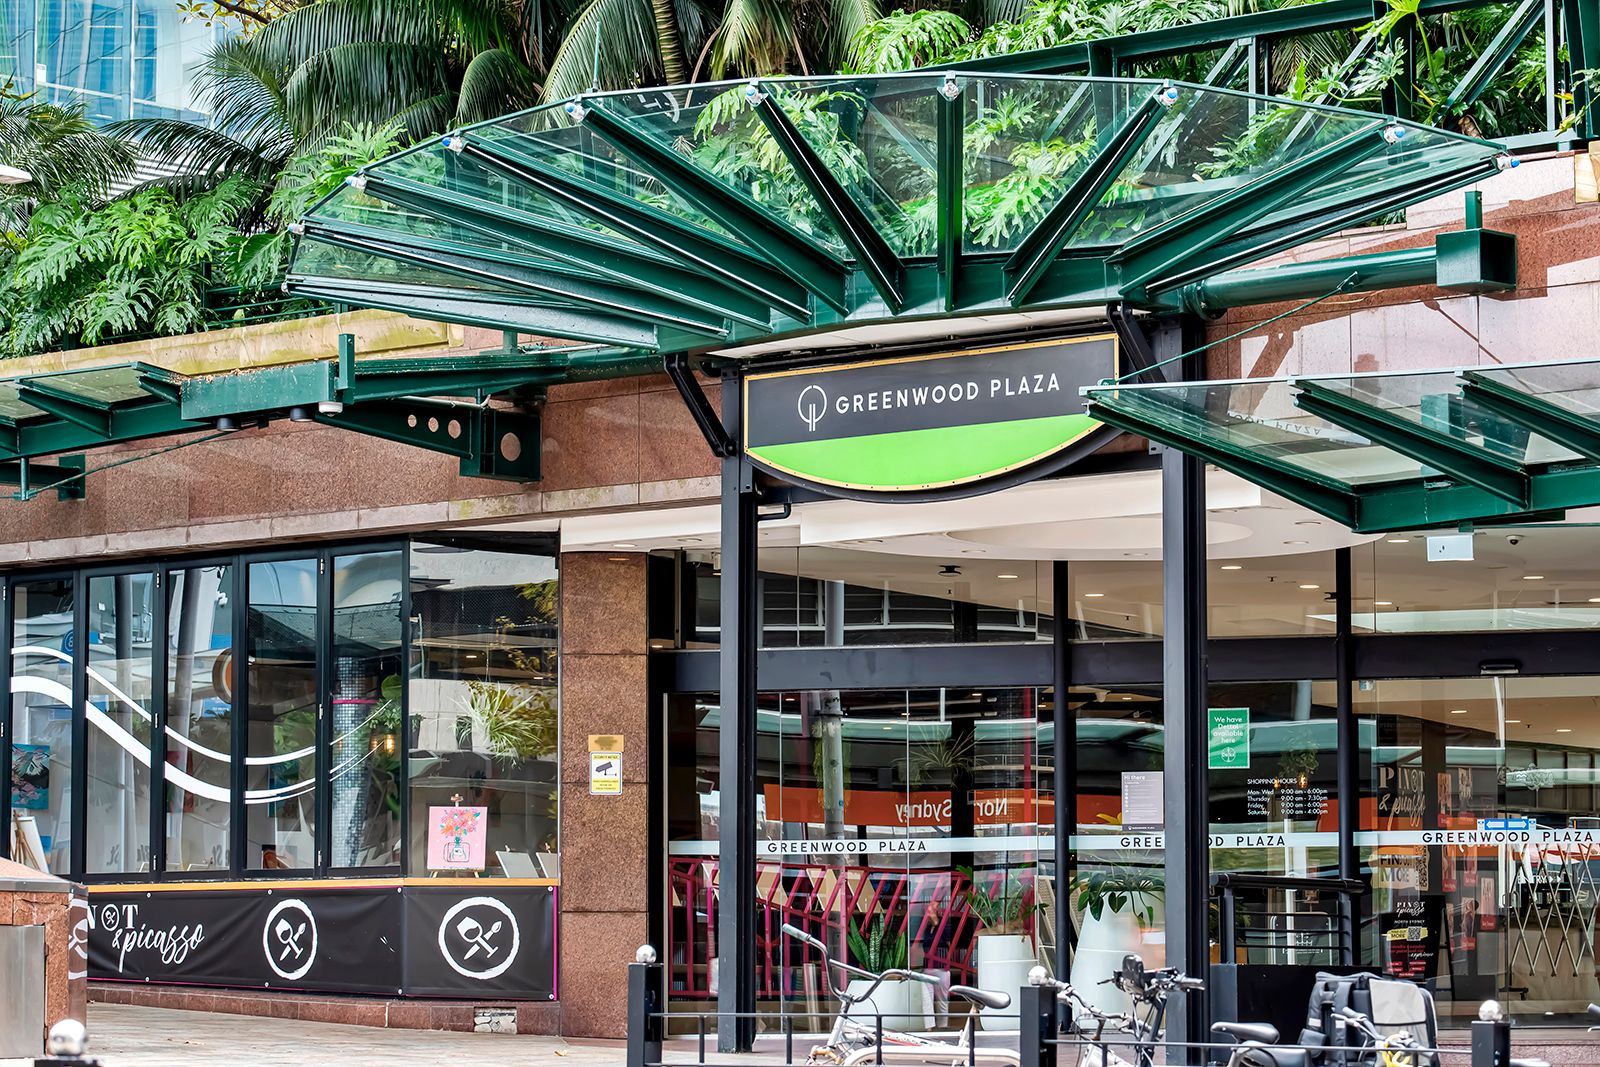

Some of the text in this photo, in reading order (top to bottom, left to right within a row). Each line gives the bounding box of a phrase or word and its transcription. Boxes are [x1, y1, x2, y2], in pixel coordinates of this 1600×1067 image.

[835, 373, 1060, 414] GREENWOOD PLAZA
[1237, 835, 1285, 846] PLAZA
[1422, 831, 1594, 843] GREENWOOD PLAZA
[767, 840, 927, 853] GREENWOOD PLAZA
